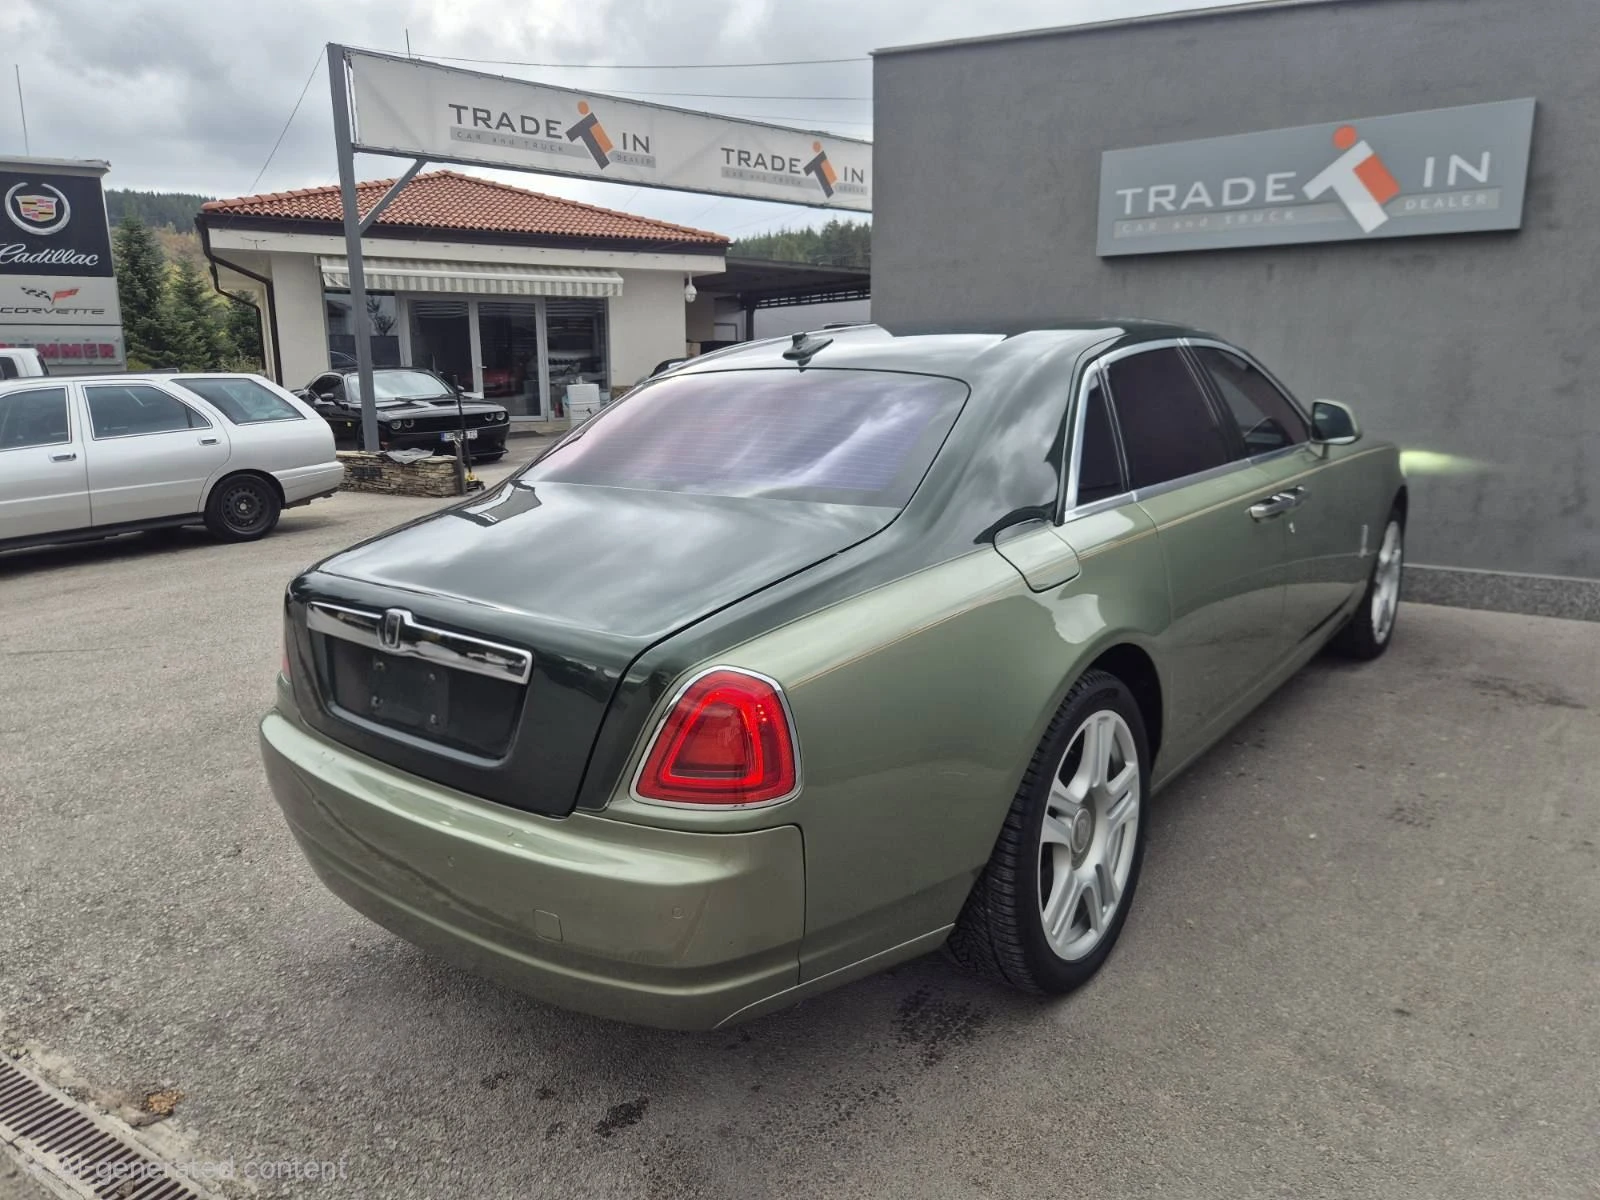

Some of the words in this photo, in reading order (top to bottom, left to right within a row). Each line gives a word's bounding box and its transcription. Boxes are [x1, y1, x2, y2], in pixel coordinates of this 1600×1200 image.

[448, 103, 563, 139] TRADE
[622, 132, 650, 154] IN
[720, 147, 801, 174] TRADE
[844, 166, 864, 184] IN
[1115, 171, 1298, 215] TRADE
[1423, 151, 1491, 188] IN
[1404, 193, 1487, 210] DEALER
[0, 243, 99, 266] Cadillac
[0, 307, 105, 315] CORVETTE
